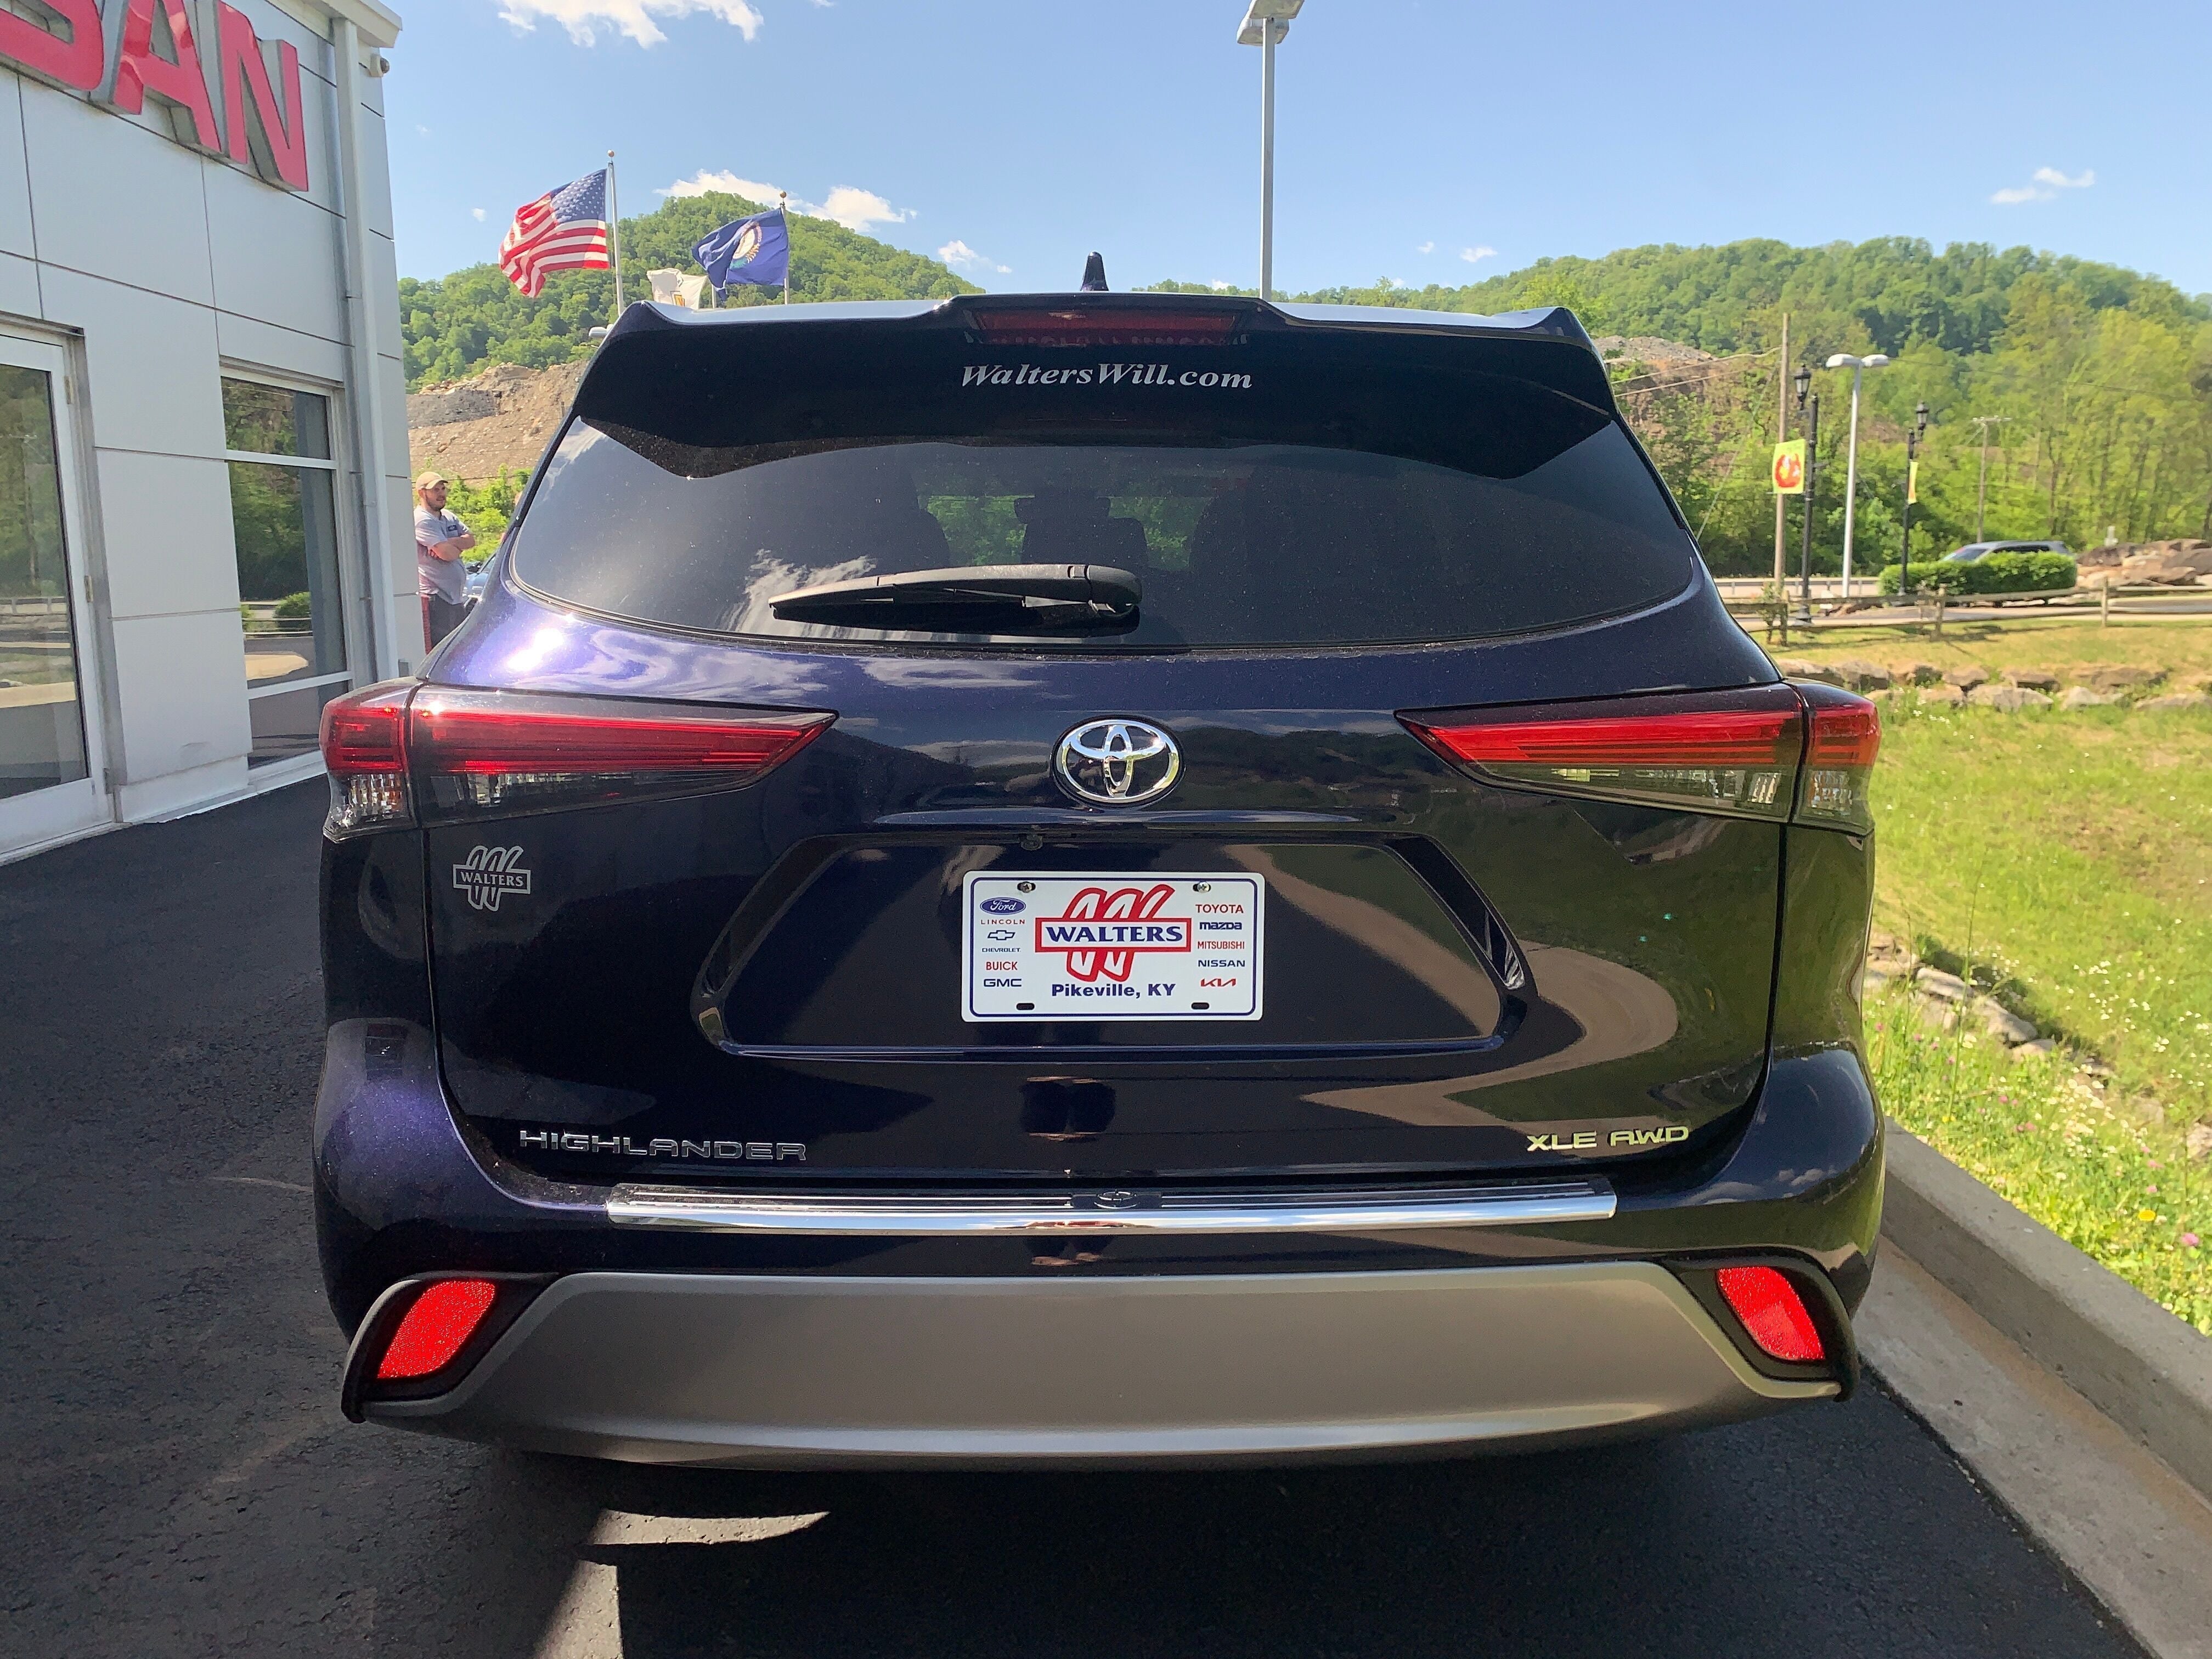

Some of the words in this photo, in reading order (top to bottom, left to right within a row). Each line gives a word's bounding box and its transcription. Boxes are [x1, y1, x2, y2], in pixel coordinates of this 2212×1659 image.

[962, 363, 1252, 389] WaltersWill.com
[460, 872, 523, 887] WALTERS
[990, 900, 1017, 911] Ford
[1195, 905, 1244, 913] TOYOTA
[1046, 926, 1182, 942] WALTERS
[1197, 941, 1245, 949] MITSUBISHI
[986, 962, 1018, 970] BUICK
[984, 979, 1022, 987] GMC
[1052, 984, 1140, 998] Pikeville,
[1148, 984, 1176, 996] KY
[520, 1130, 806, 1160] HIGHLANDER
[1527, 1131, 1597, 1151] XLE
[1610, 1126, 1689, 1147] AWD
